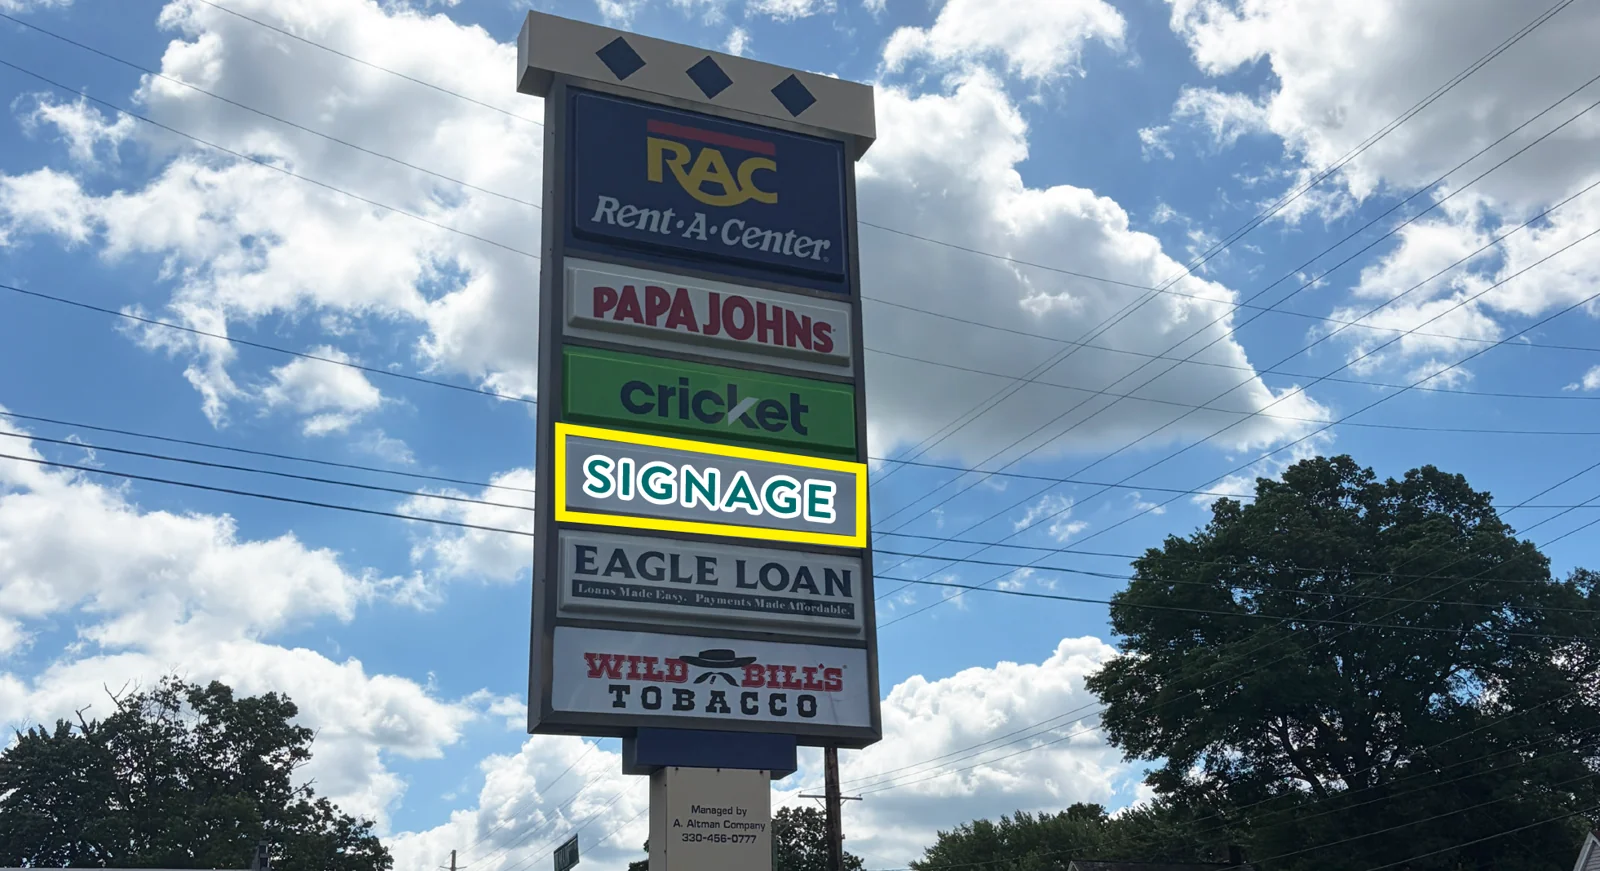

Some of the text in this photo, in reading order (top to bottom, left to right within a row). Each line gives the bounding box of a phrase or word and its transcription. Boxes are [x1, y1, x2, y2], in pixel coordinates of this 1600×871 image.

[647, 136, 778, 207] RAC
[593, 285, 834, 354] PAPA JOHNS
[620, 377, 809, 436] cricket
[574, 544, 853, 598] EAGLE LOAN
[578, 583, 617, 596] Loans
[619, 587, 653, 599] Made
[695, 593, 752, 607] Payments
[754, 598, 786, 610] Made
[787, 601, 851, 615] Affordable.
[584, 652, 843, 692] WILD BILL'S
[608, 684, 817, 718] TOBACCO
[672, 819, 766, 832] A. Altman Company
[691, 805, 748, 816] Managed by
[681, 833, 757, 844] 330-456-0777
